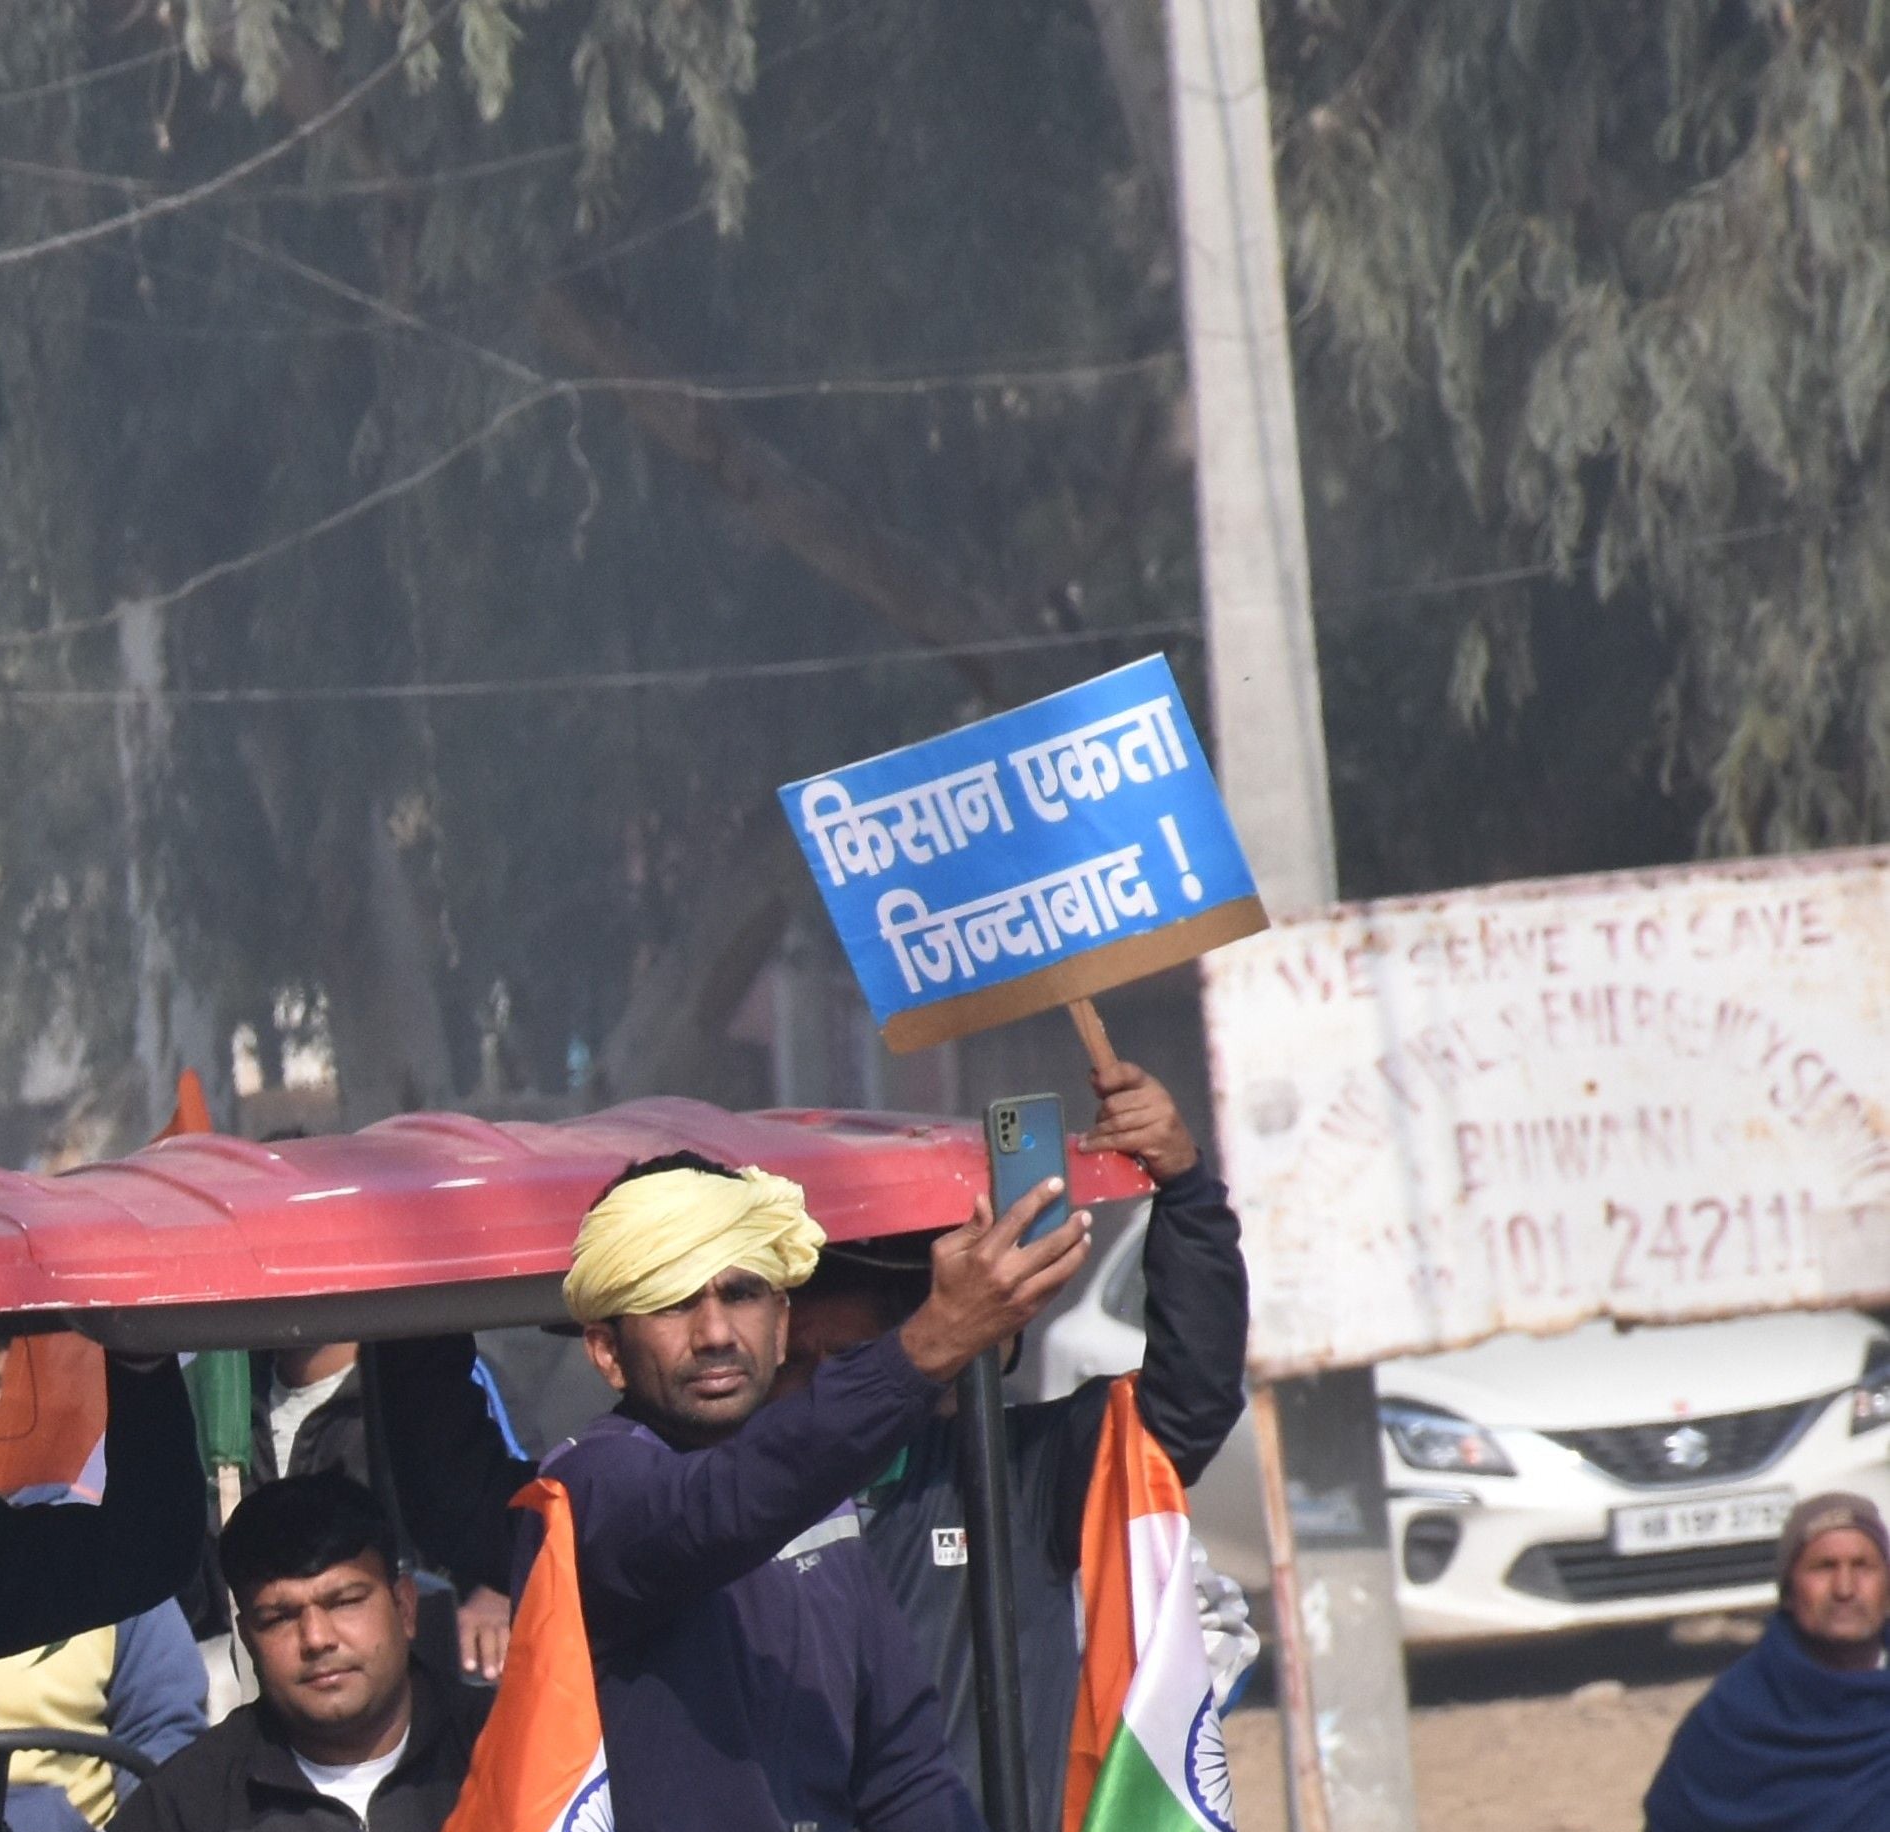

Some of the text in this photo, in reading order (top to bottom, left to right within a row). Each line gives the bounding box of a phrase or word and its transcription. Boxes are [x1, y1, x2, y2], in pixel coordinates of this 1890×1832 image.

[801, 695, 1188, 887] किसान एकता
[876, 814, 1203, 994] जिन्दाबाद !
[1594, 918, 1669, 962] TO
[1687, 899, 1833, 960] SAVE
